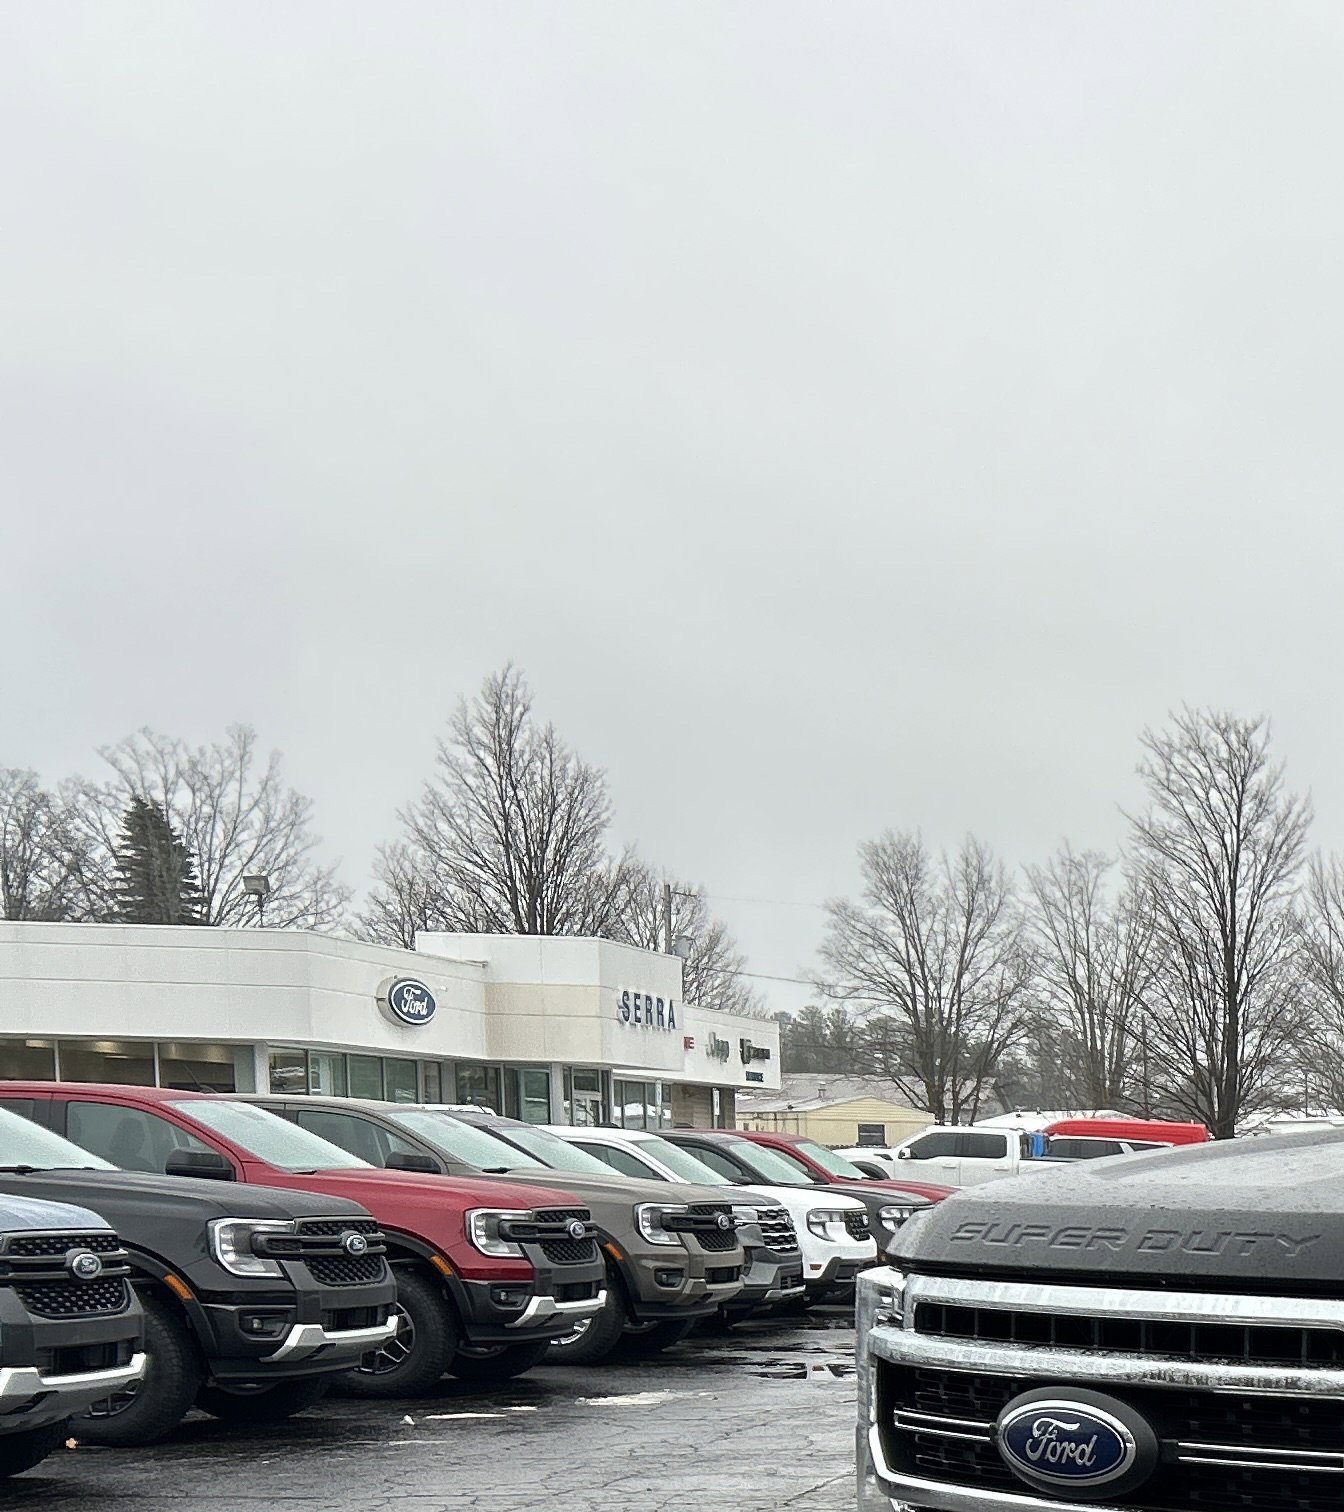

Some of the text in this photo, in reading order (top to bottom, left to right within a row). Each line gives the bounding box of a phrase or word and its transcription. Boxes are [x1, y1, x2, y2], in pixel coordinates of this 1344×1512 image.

[400, 986, 429, 1017] Ford
[621, 989, 676, 1030] SERRA
[950, 1221, 1321, 1257] SUPER DUTY
[1025, 1417, 1097, 1467] Ford
